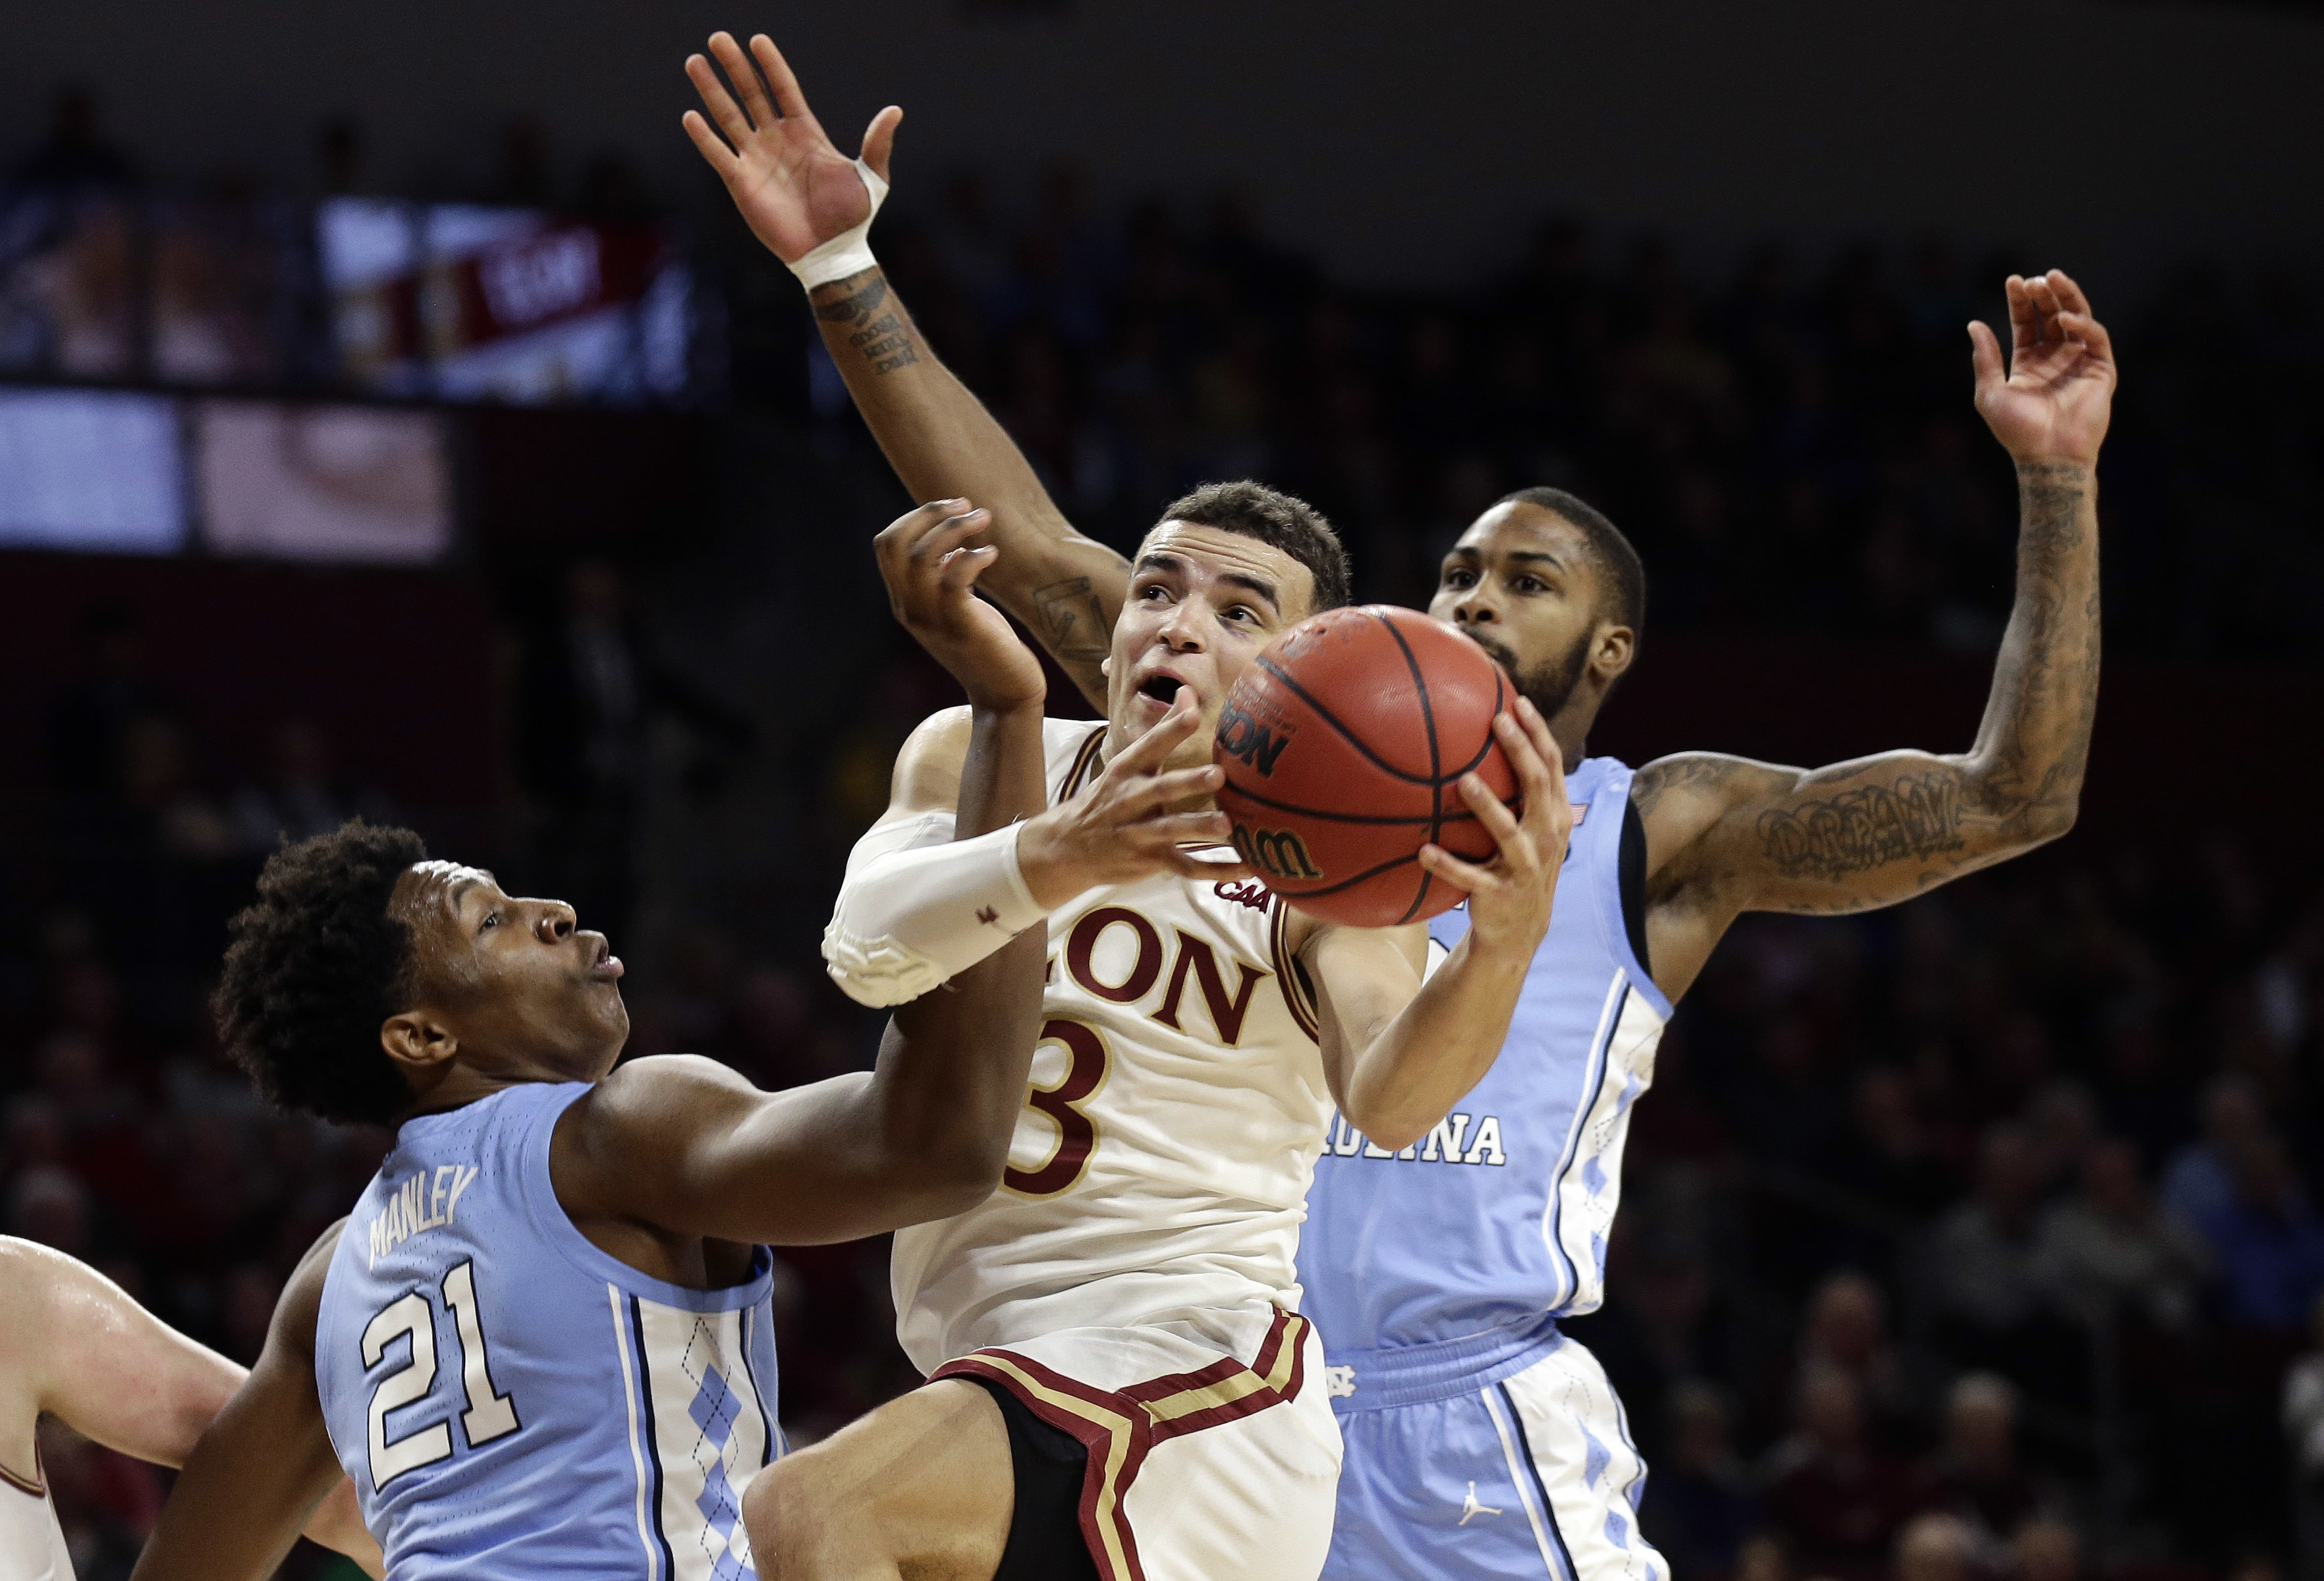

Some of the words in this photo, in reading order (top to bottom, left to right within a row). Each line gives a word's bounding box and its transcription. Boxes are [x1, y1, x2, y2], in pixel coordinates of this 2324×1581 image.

[1213, 881, 1271, 914] CAA
[1046, 904, 1277, 1049] ON
[1003, 1011, 1113, 1201] 3
[369, 1165, 479, 1271] MANLEY
[360, 1258, 522, 1495] 21
